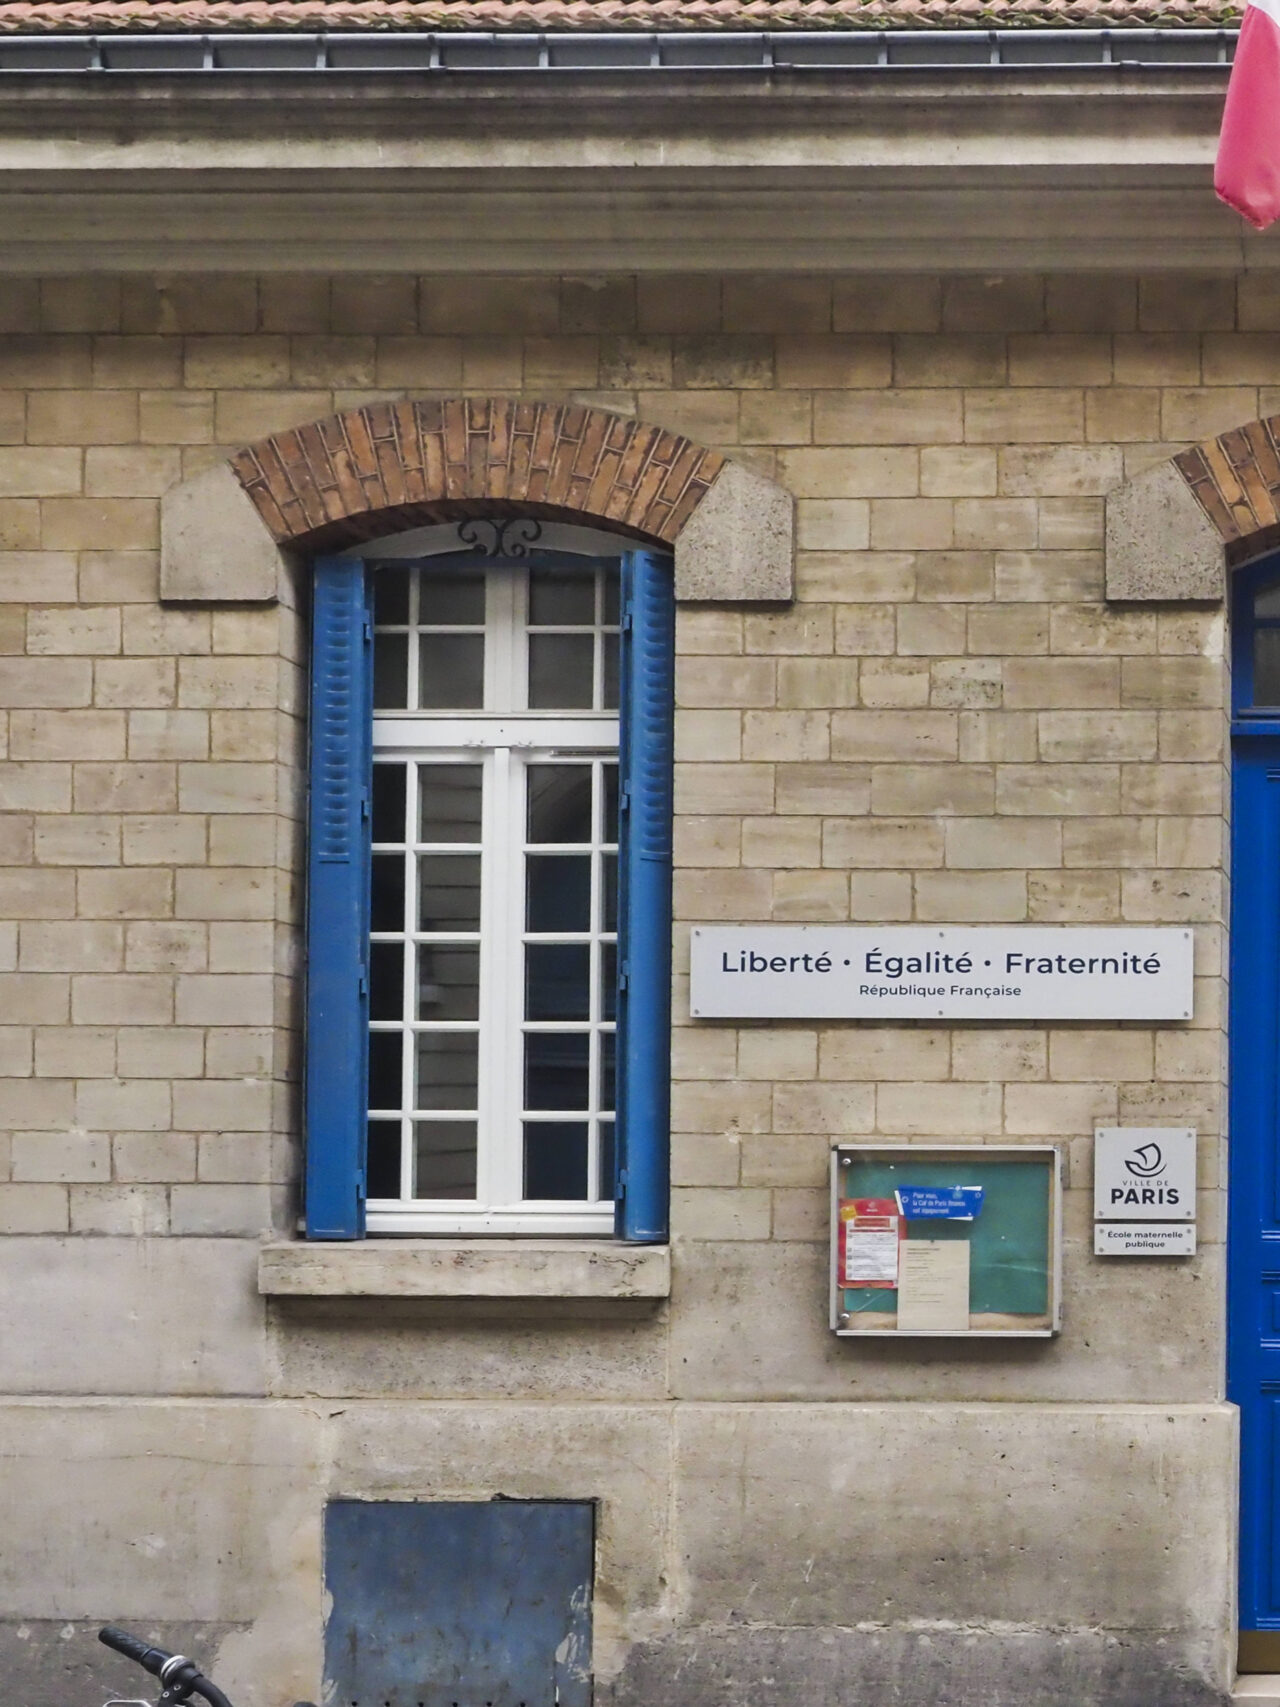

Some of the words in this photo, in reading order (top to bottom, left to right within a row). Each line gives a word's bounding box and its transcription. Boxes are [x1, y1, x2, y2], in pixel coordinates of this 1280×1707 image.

[721, 950, 833, 974] Liberté
[864, 947, 973, 979] Égalité
[1005, 951, 1161, 975] Fraternité
[859, 984, 946, 999] République
[950, 984, 1022, 999] Française
[1111, 1188, 1180, 1205] PARIS
[1107, 1230, 1132, 1239] École
[1134, 1231, 1184, 1239] maternelle
[1125, 1241, 1166, 1249] publique
